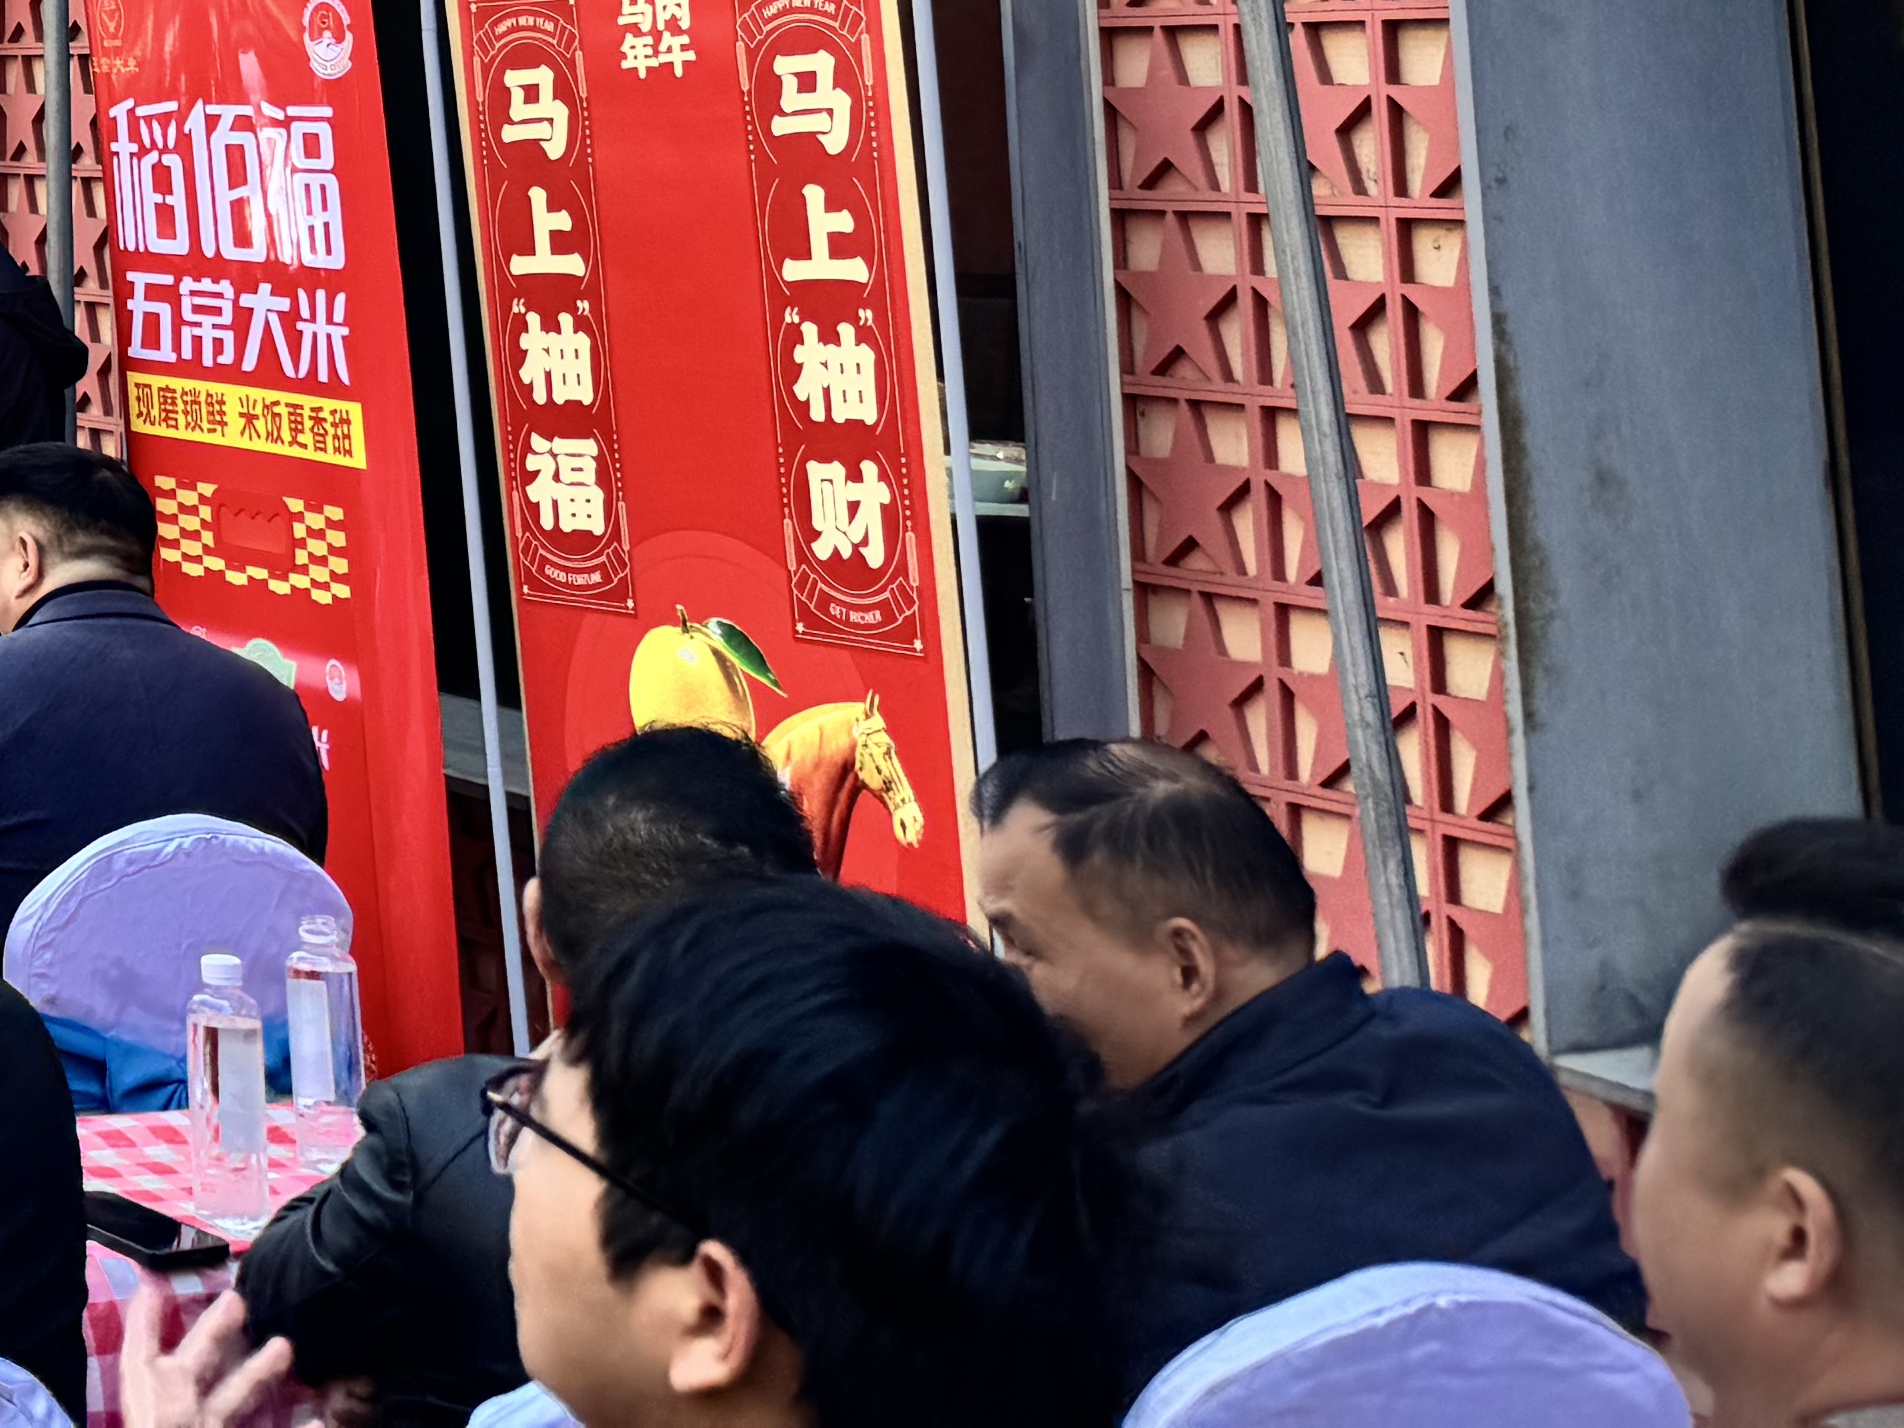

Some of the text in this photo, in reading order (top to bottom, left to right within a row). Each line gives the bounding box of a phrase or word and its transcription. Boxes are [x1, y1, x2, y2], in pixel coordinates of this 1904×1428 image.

[494, 15, 555, 35] HAPPY NEW YEAR
[109, 97, 345, 270] 稻佰福
[125, 270, 351, 386] 五常大米
[134, 381, 354, 459] 现磨锁鲜 米饭更香甜
[544, 564, 603, 585] GOOD FORTUNE
[829, 603, 847, 621] GET
